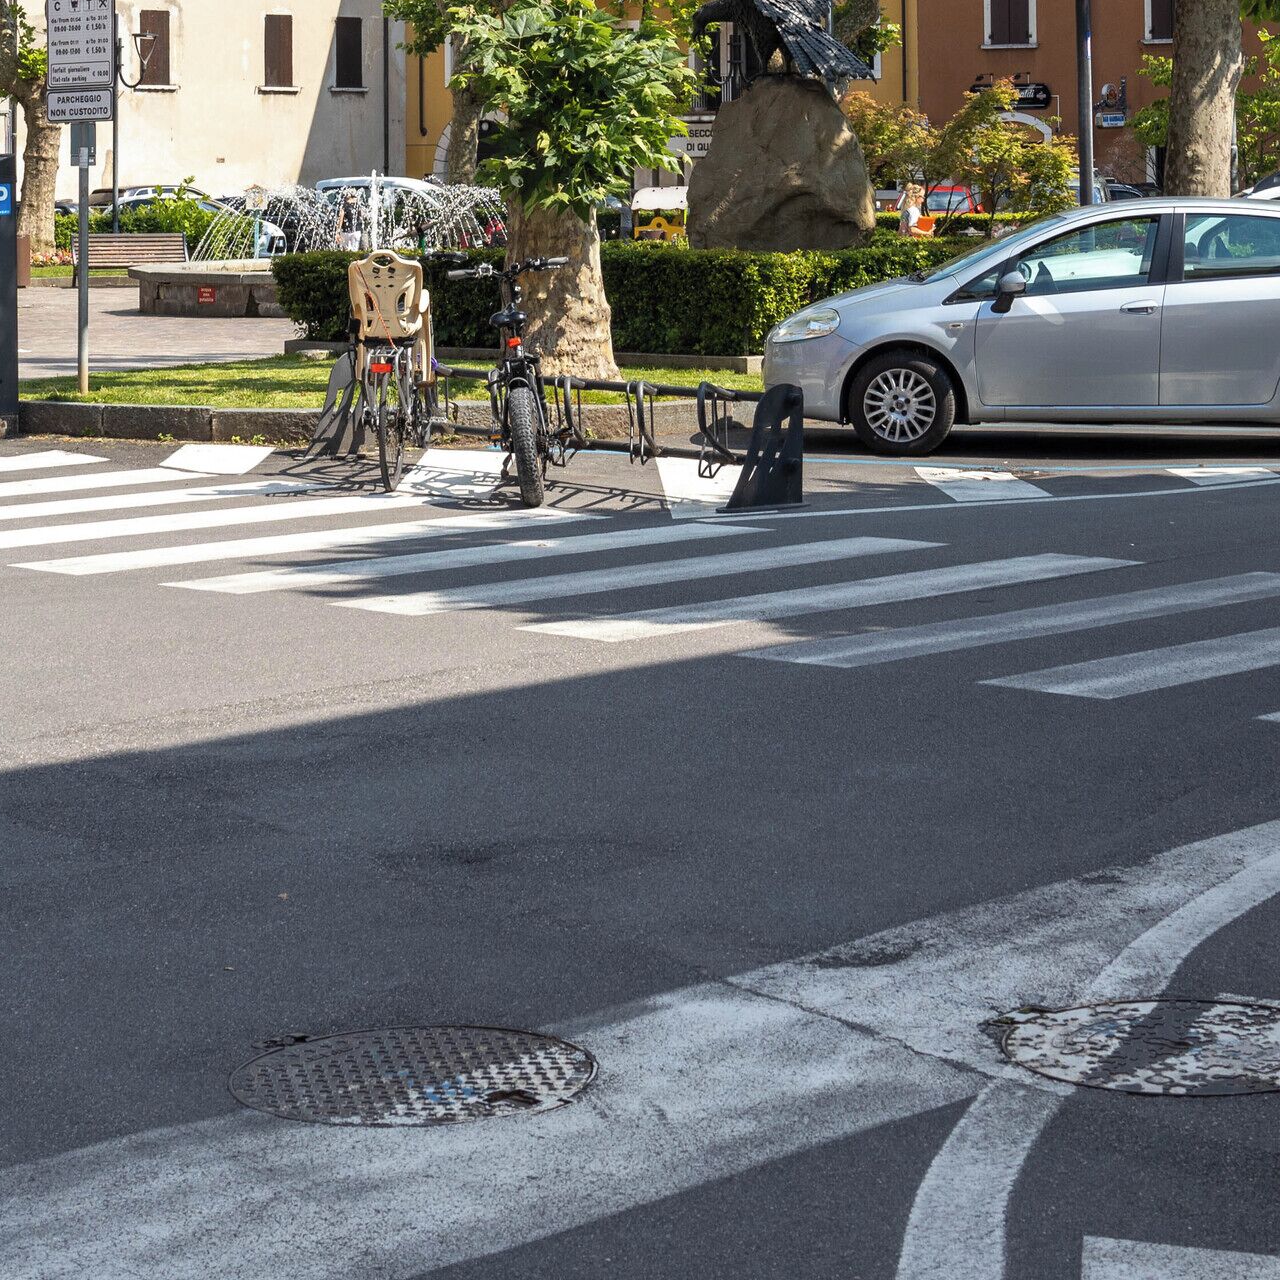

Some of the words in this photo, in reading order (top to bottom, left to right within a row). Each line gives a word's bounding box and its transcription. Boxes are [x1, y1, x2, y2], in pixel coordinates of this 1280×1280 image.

[54, 2, 60, 11] C
[57, 95, 101, 104] PARCHEGGIO
[69, 107, 108, 116] CUSTODITO
